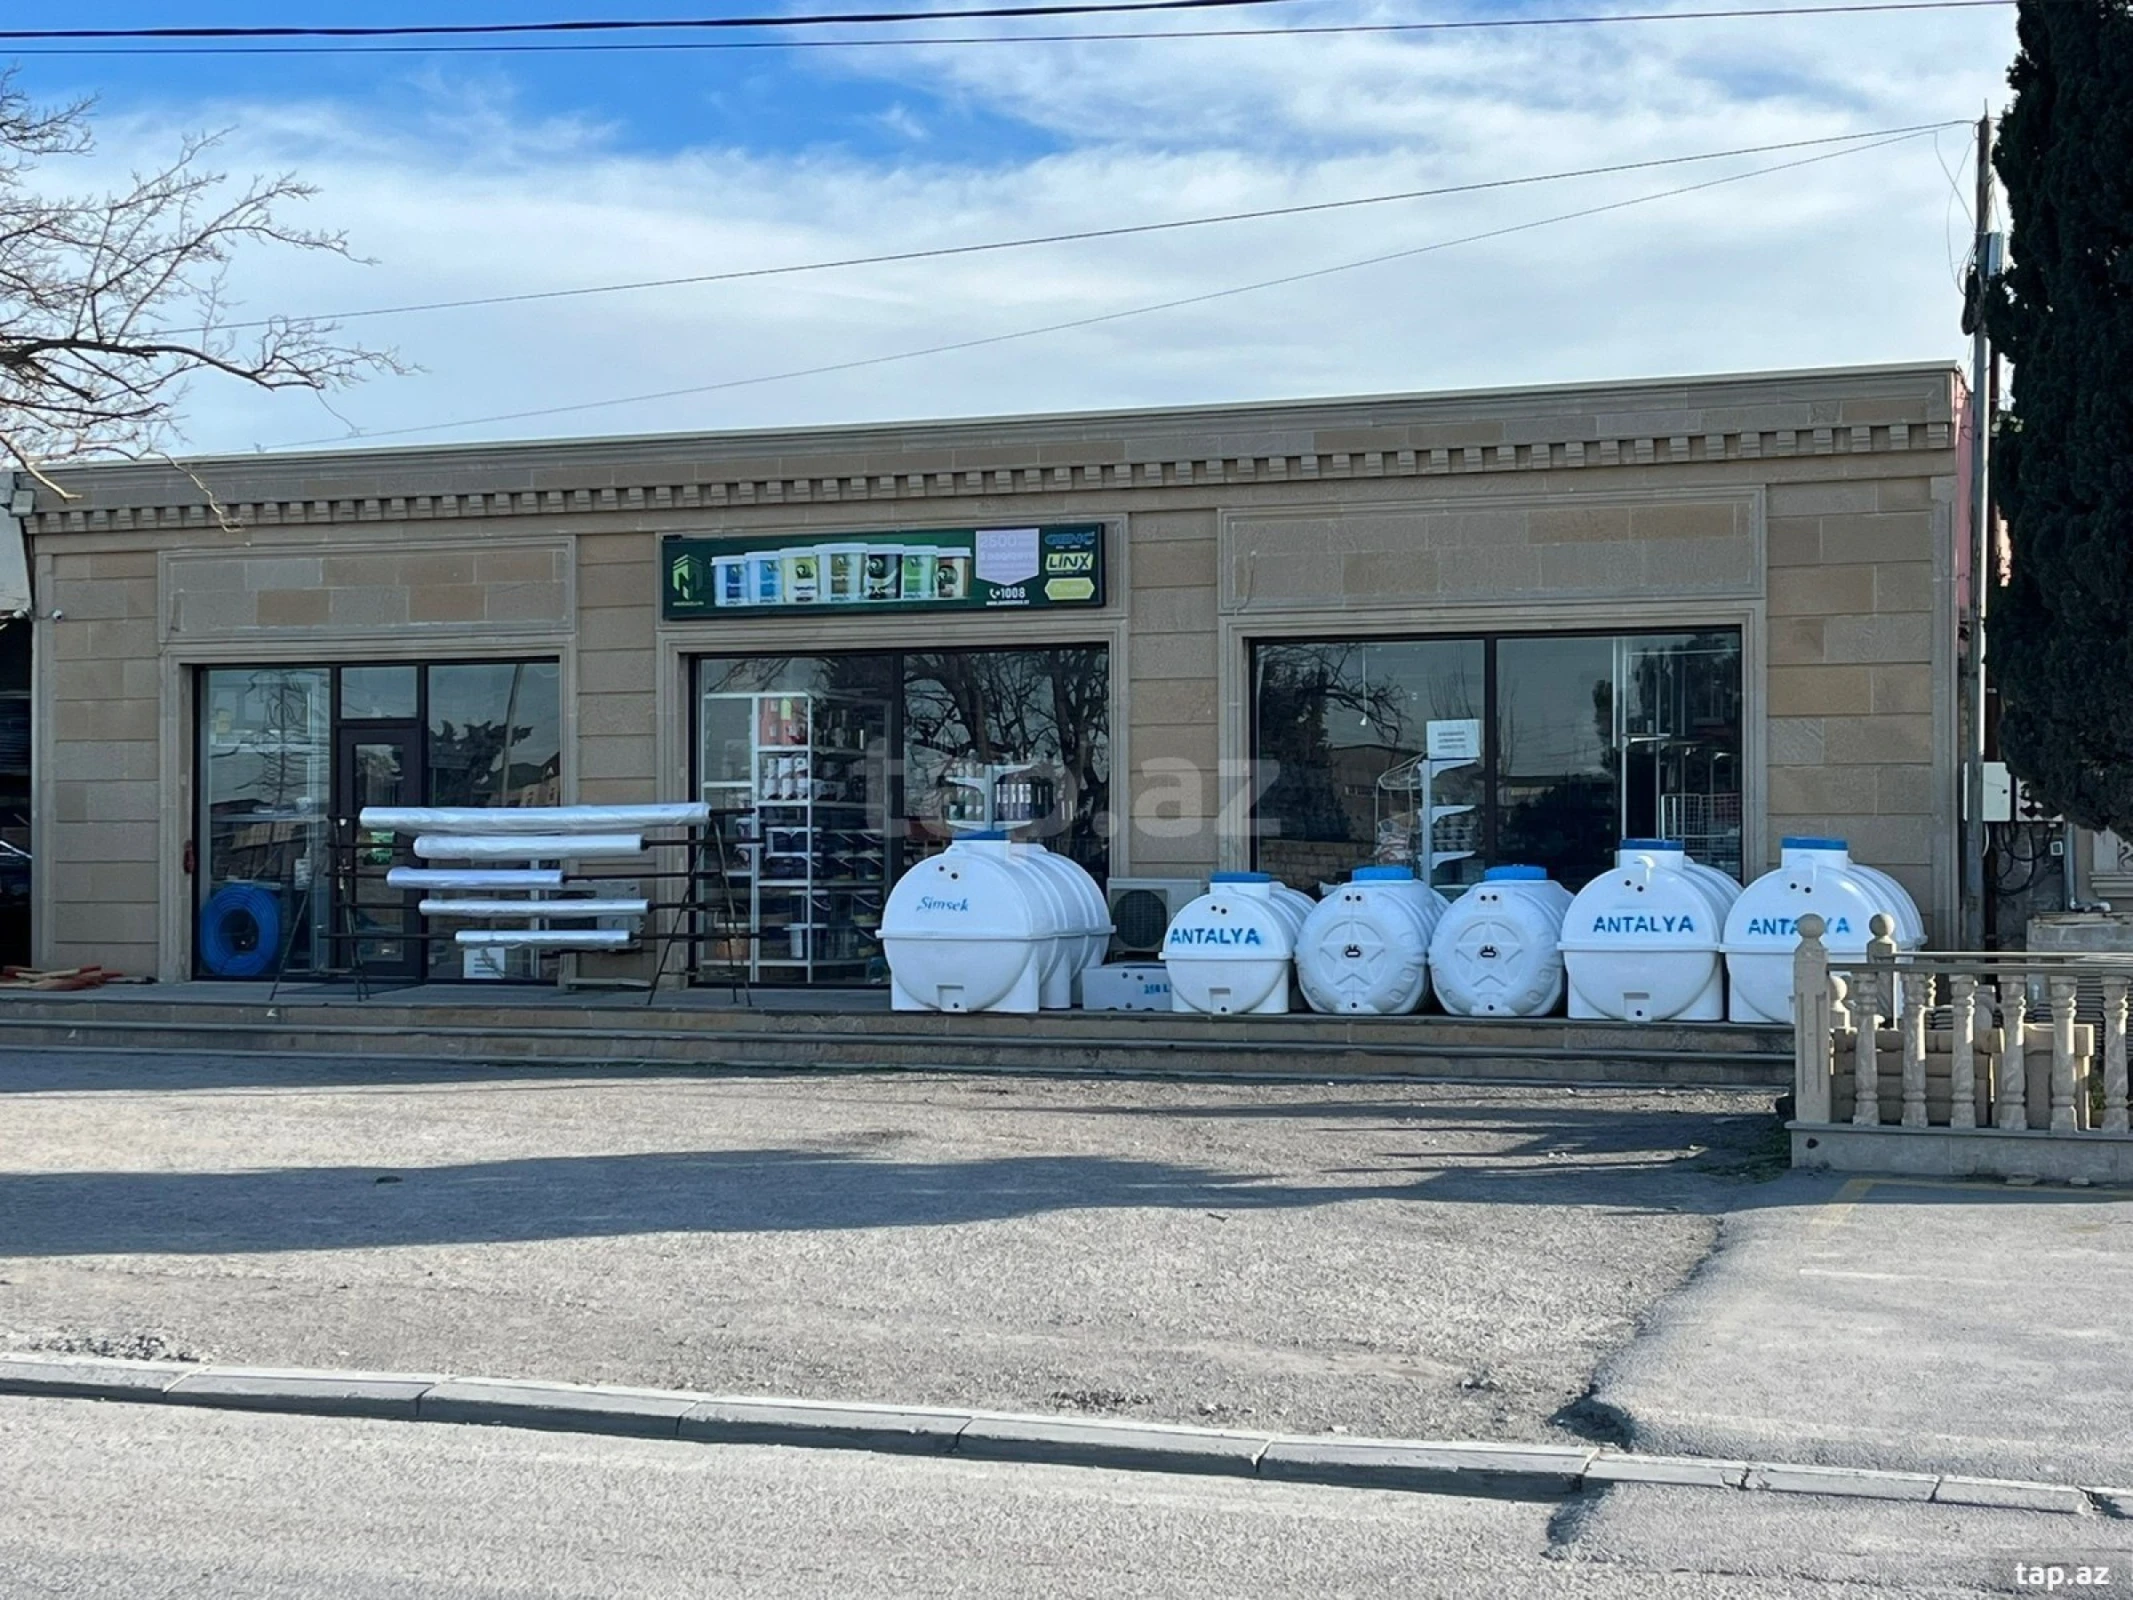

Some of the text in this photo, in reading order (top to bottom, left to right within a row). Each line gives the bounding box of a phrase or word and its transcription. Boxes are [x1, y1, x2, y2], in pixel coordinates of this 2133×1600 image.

[1001, 587, 1026, 599] 1008
[1592, 915, 1694, 933] ANTALYA
[1169, 927, 1261, 945] ANTALYA
